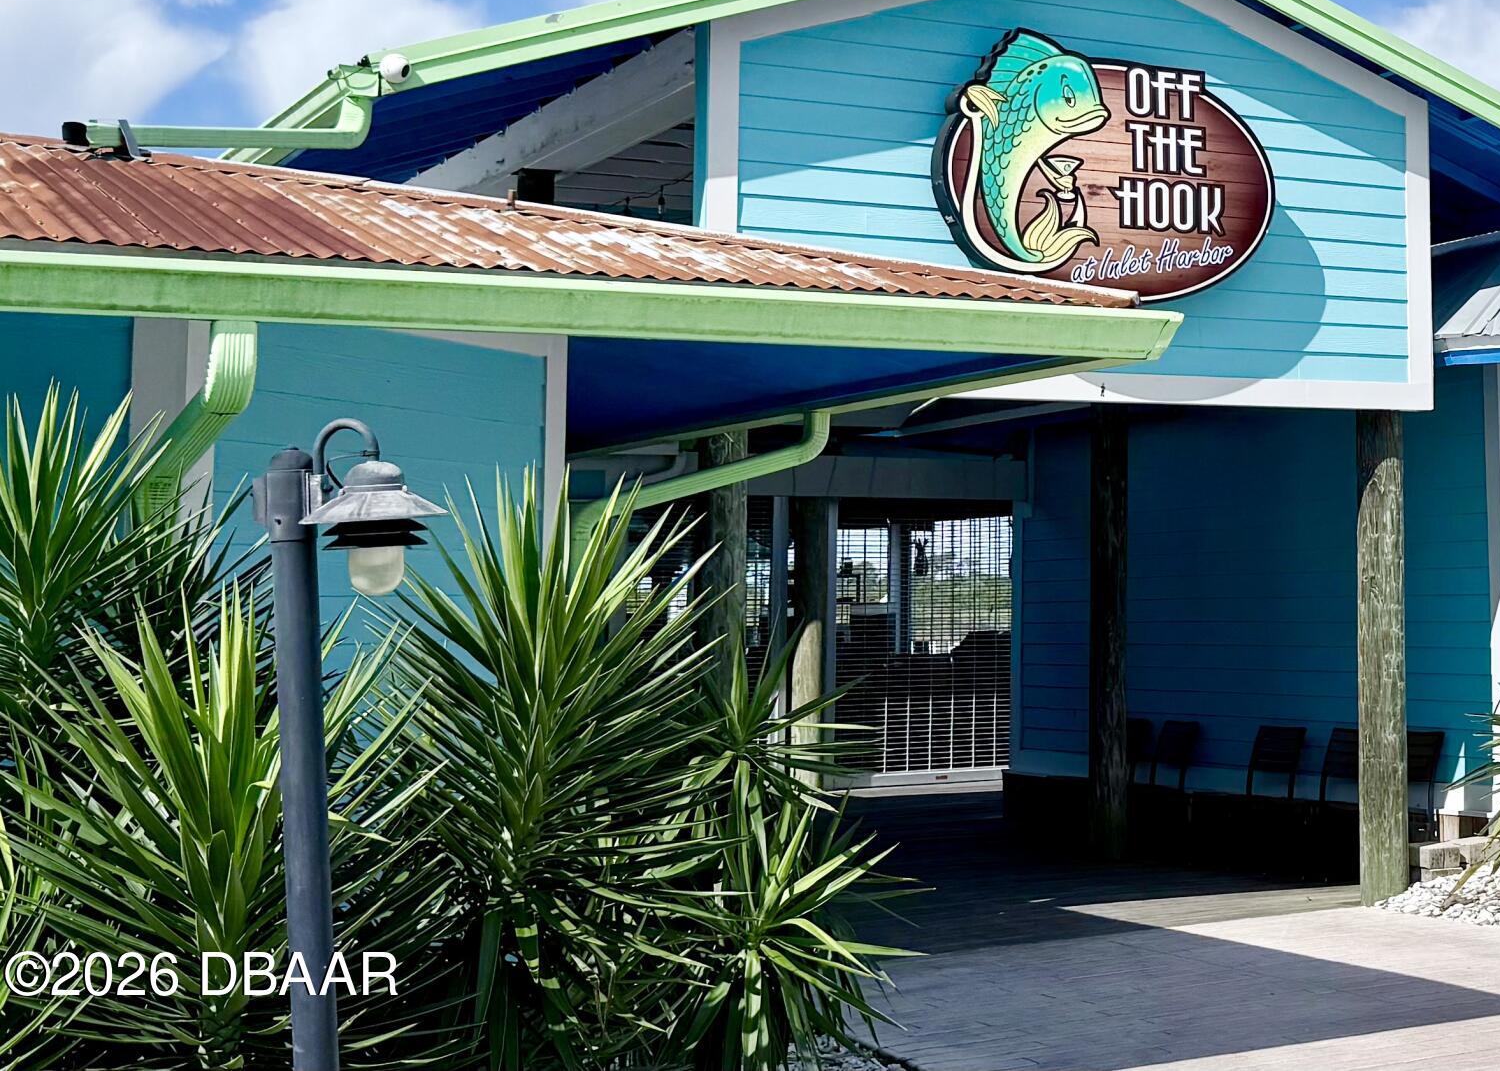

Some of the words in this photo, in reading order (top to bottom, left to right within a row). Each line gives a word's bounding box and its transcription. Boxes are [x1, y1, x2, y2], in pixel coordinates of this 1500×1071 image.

[1127, 67, 1202, 120] OFF
[1127, 123, 1203, 175] THE
[1115, 179, 1225, 235] HOOK
[1072, 257, 1096, 282] at
[1099, 244, 1151, 279] Inlet
[1157, 237, 1233, 273] Harbor
